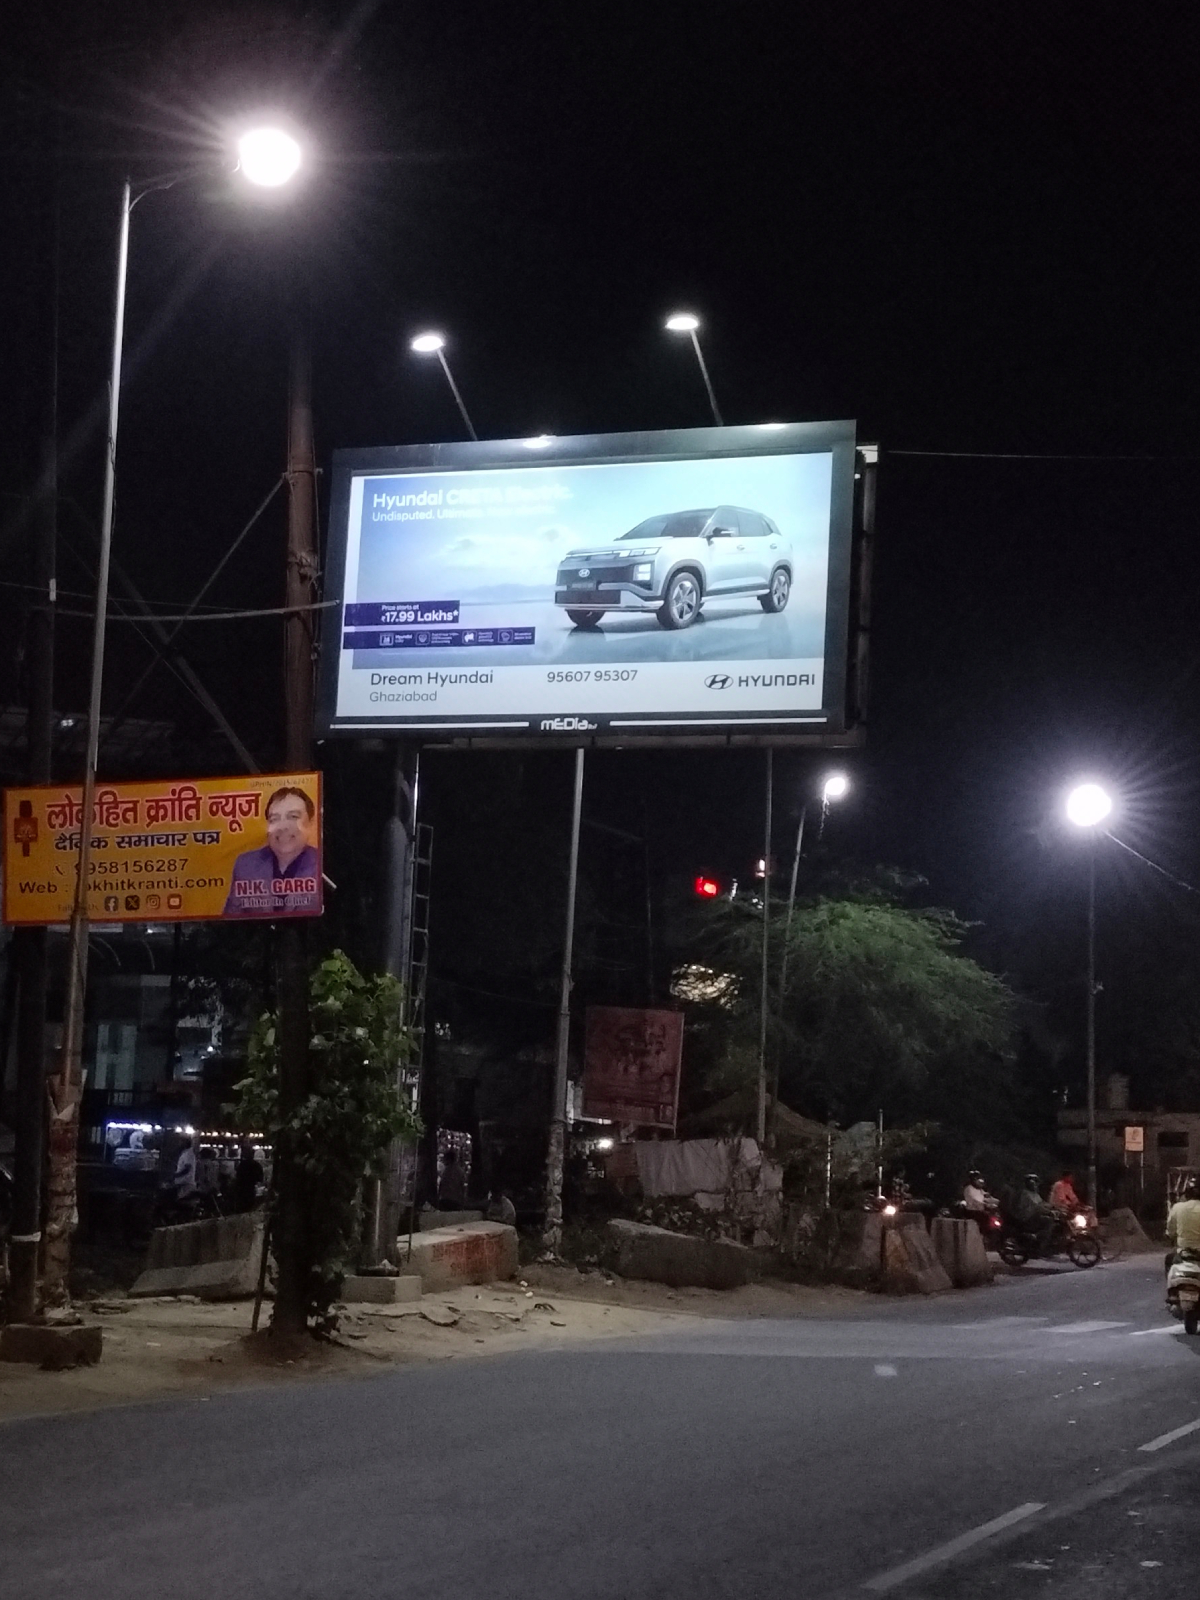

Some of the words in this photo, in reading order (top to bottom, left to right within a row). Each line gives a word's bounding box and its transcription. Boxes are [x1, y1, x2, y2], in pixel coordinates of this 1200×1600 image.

[373, 489, 442, 510] Hyundai
[372, 509, 435, 523] Undisputed.
[370, 672, 423, 686] Dream
[427, 670, 494, 688] Hyundai
[547, 670, 591, 684] 95607
[594, 669, 638, 683] 95307
[738, 673, 815, 688] HYUNDAI
[369, 690, 438, 703] Ghaziabad
[116, 832, 187, 849] समाचार
[193, 830, 221, 845] पत्र
[19, 880, 58, 895] Web
[77, 875, 225, 893] khitkranti.com
[236, 881, 268, 897] N.K.
[272, 878, 316, 895] GARG
